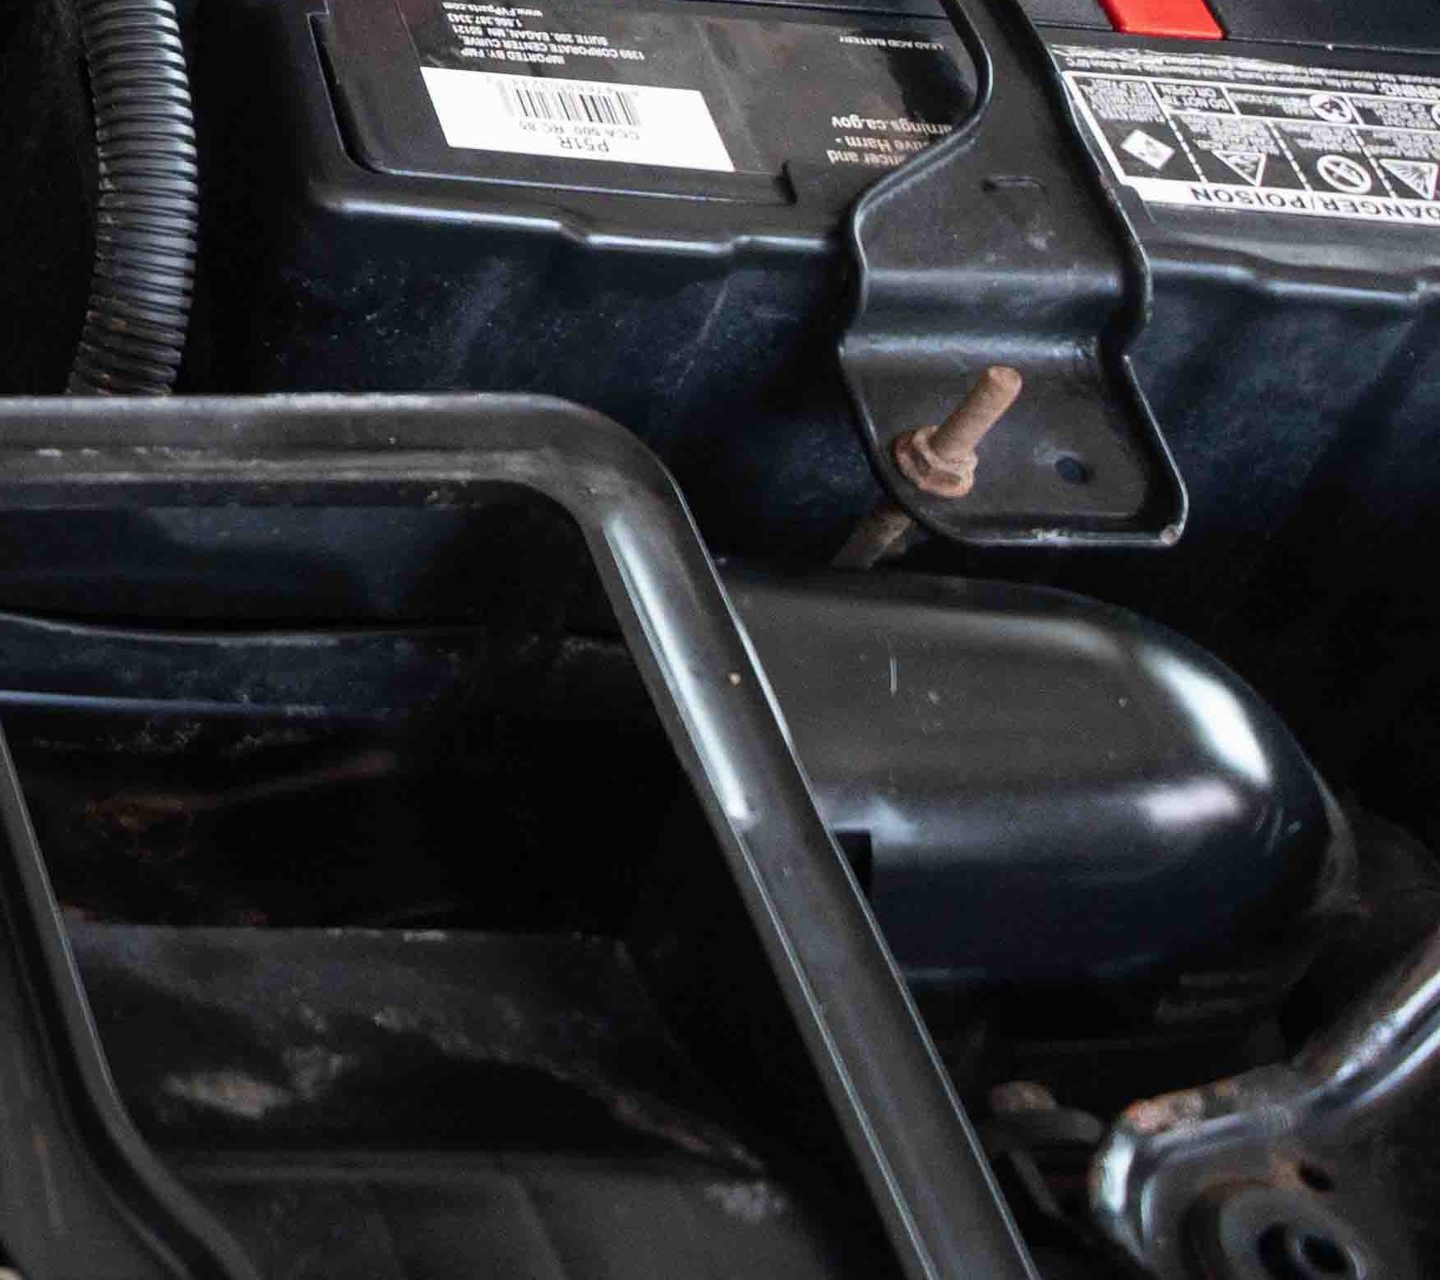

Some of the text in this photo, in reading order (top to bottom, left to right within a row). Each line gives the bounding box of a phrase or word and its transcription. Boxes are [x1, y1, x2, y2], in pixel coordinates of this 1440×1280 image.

[501, 38, 548, 51] CENTER
[840, 35, 886, 47] BATTERY
[508, 51, 565, 64] IMPORTED
[559, 136, 609, 152] P51R
[844, 135, 892, 153] Harm
[826, 149, 860, 165] and
